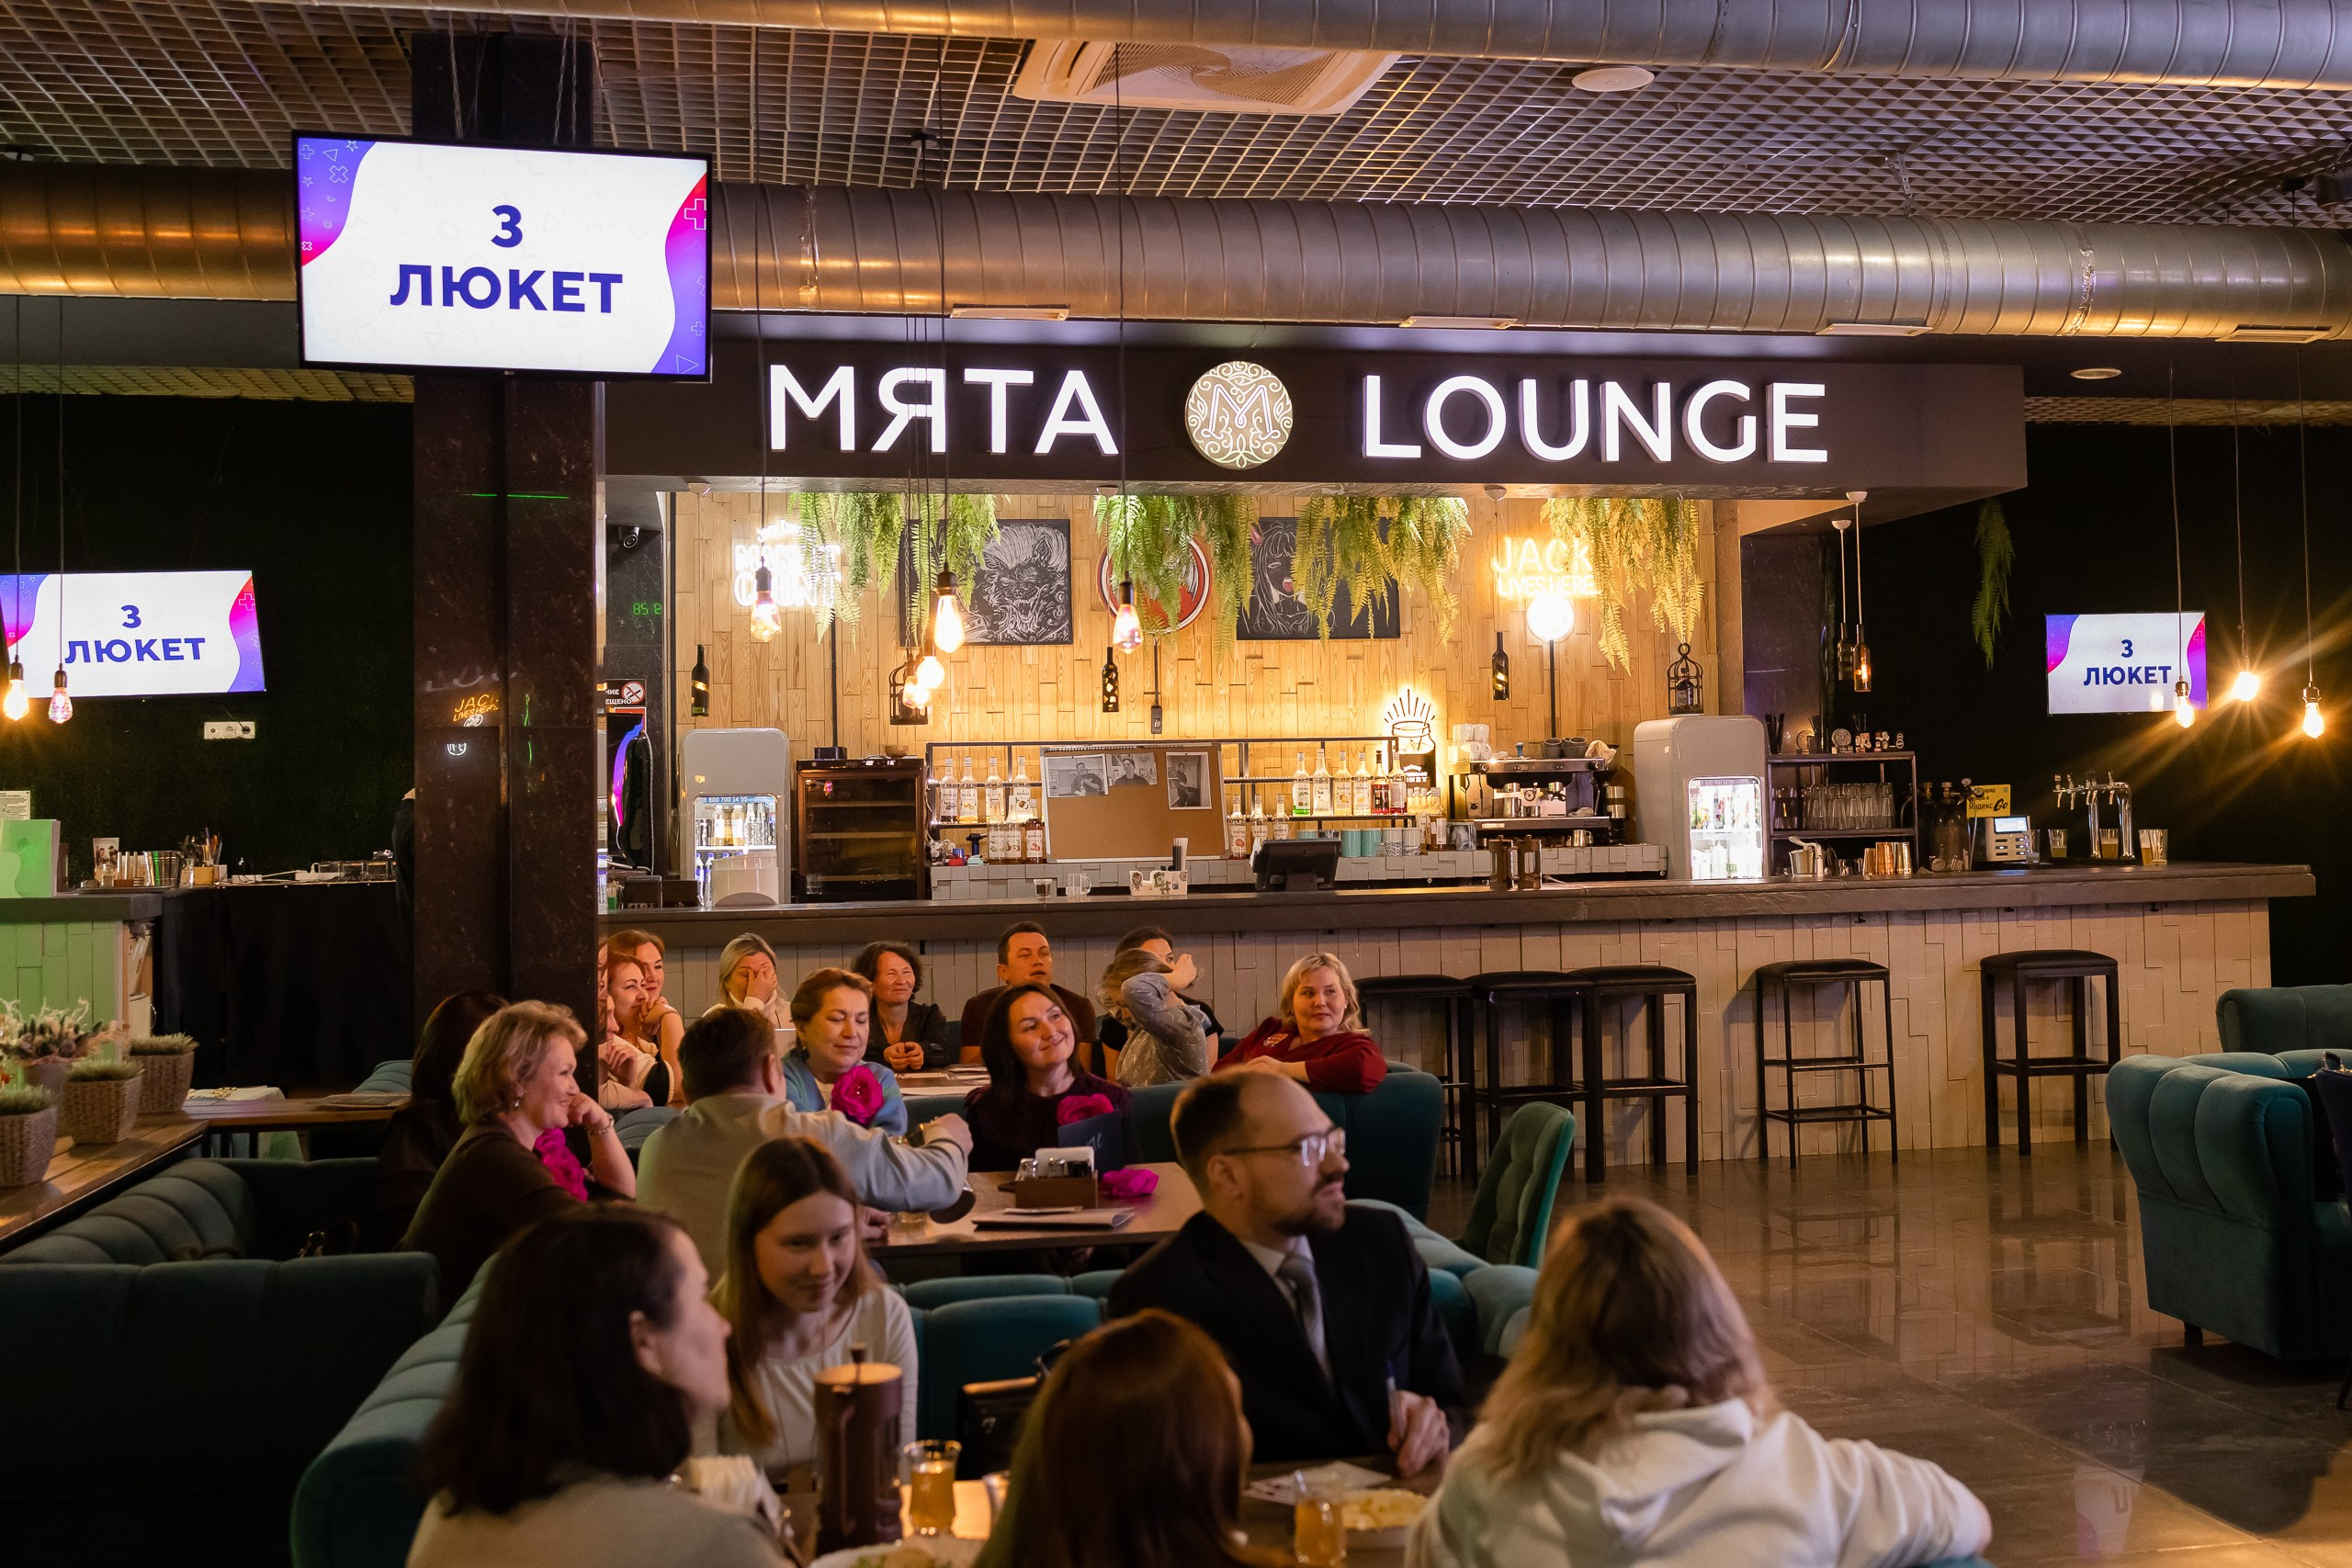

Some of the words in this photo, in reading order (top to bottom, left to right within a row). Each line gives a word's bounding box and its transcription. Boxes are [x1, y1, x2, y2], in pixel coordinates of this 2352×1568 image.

[390, 263, 624, 314] ЛЮКЕТ
[770, 363, 1120, 457] МЯТА
[1362, 375, 1828, 464] LOUNGE
[1492, 536, 1594, 573] JACK
[1498, 575, 1545, 597] LIVES
[64, 637, 206, 664] ЛЮКЕТ
[2083, 665, 2172, 686] ЛЮКЕТ
[1994, 798, 2008, 812] Go
